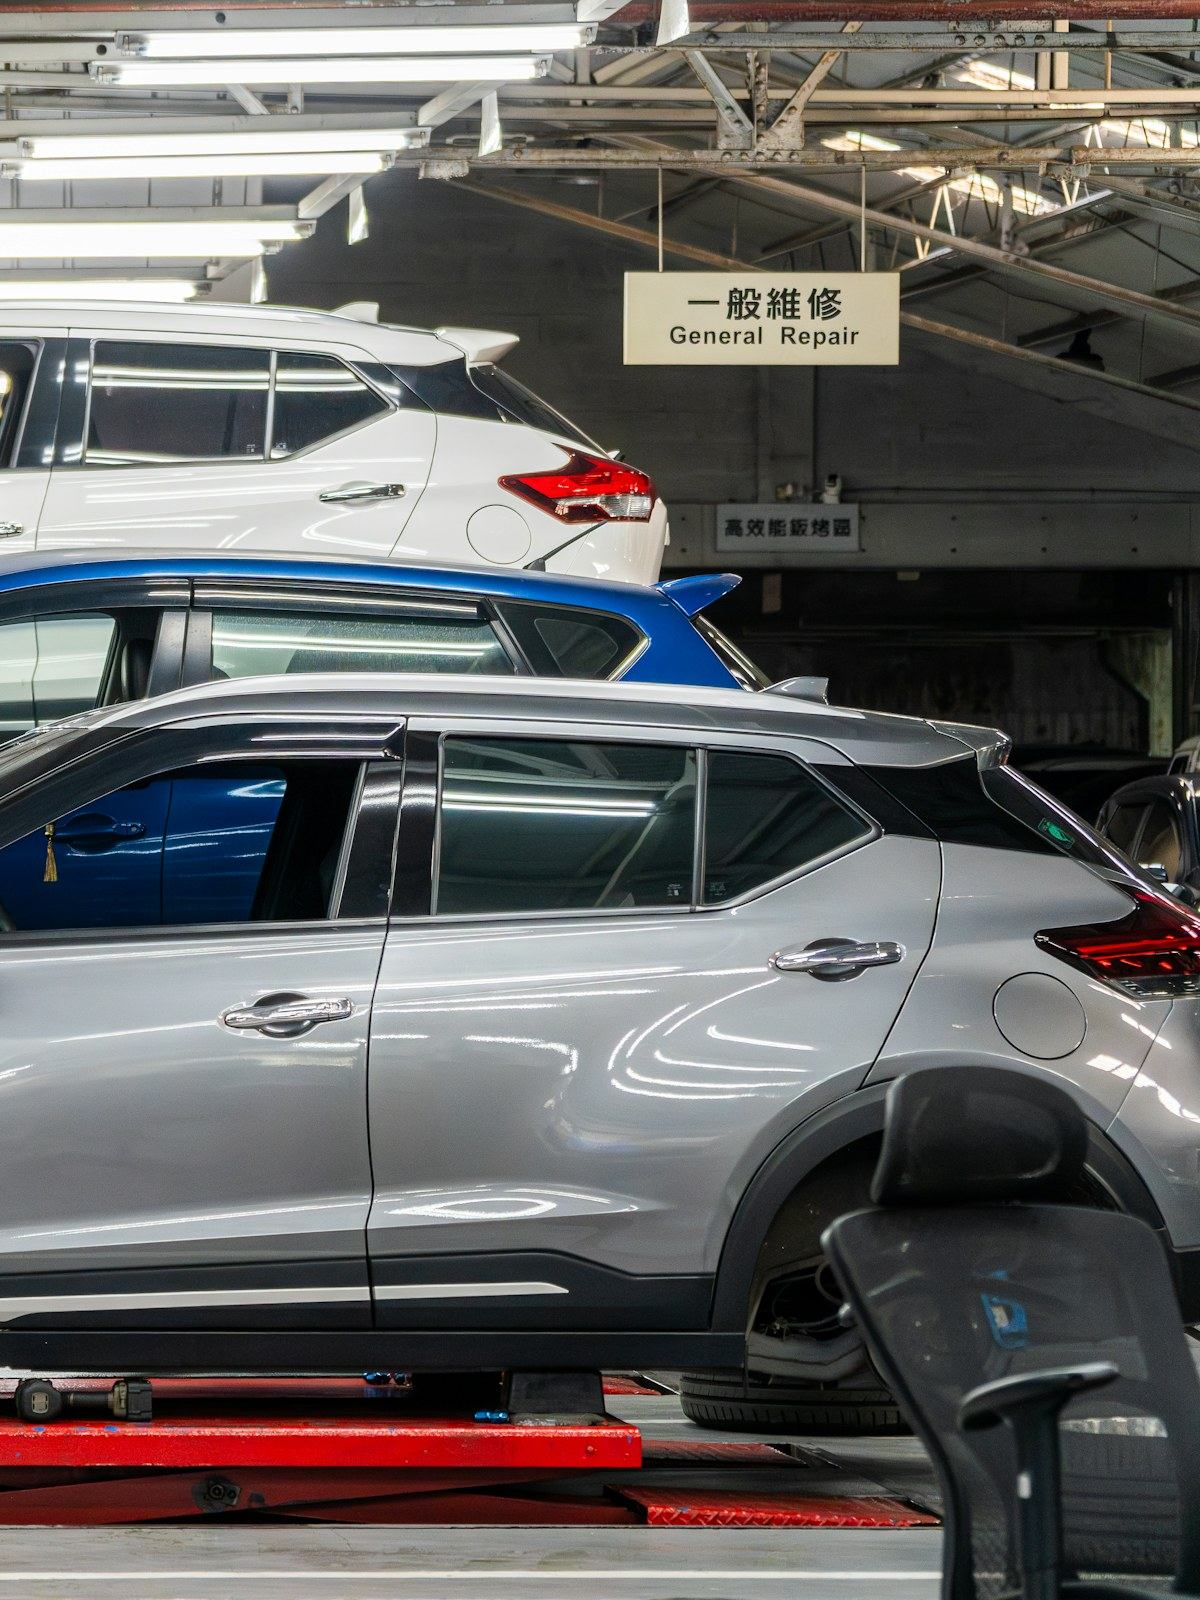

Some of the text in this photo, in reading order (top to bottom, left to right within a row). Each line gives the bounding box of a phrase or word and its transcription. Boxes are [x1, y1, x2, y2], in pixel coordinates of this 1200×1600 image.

[687, 287, 842, 321] 一般維修
[669, 326, 859, 350] General Repair
